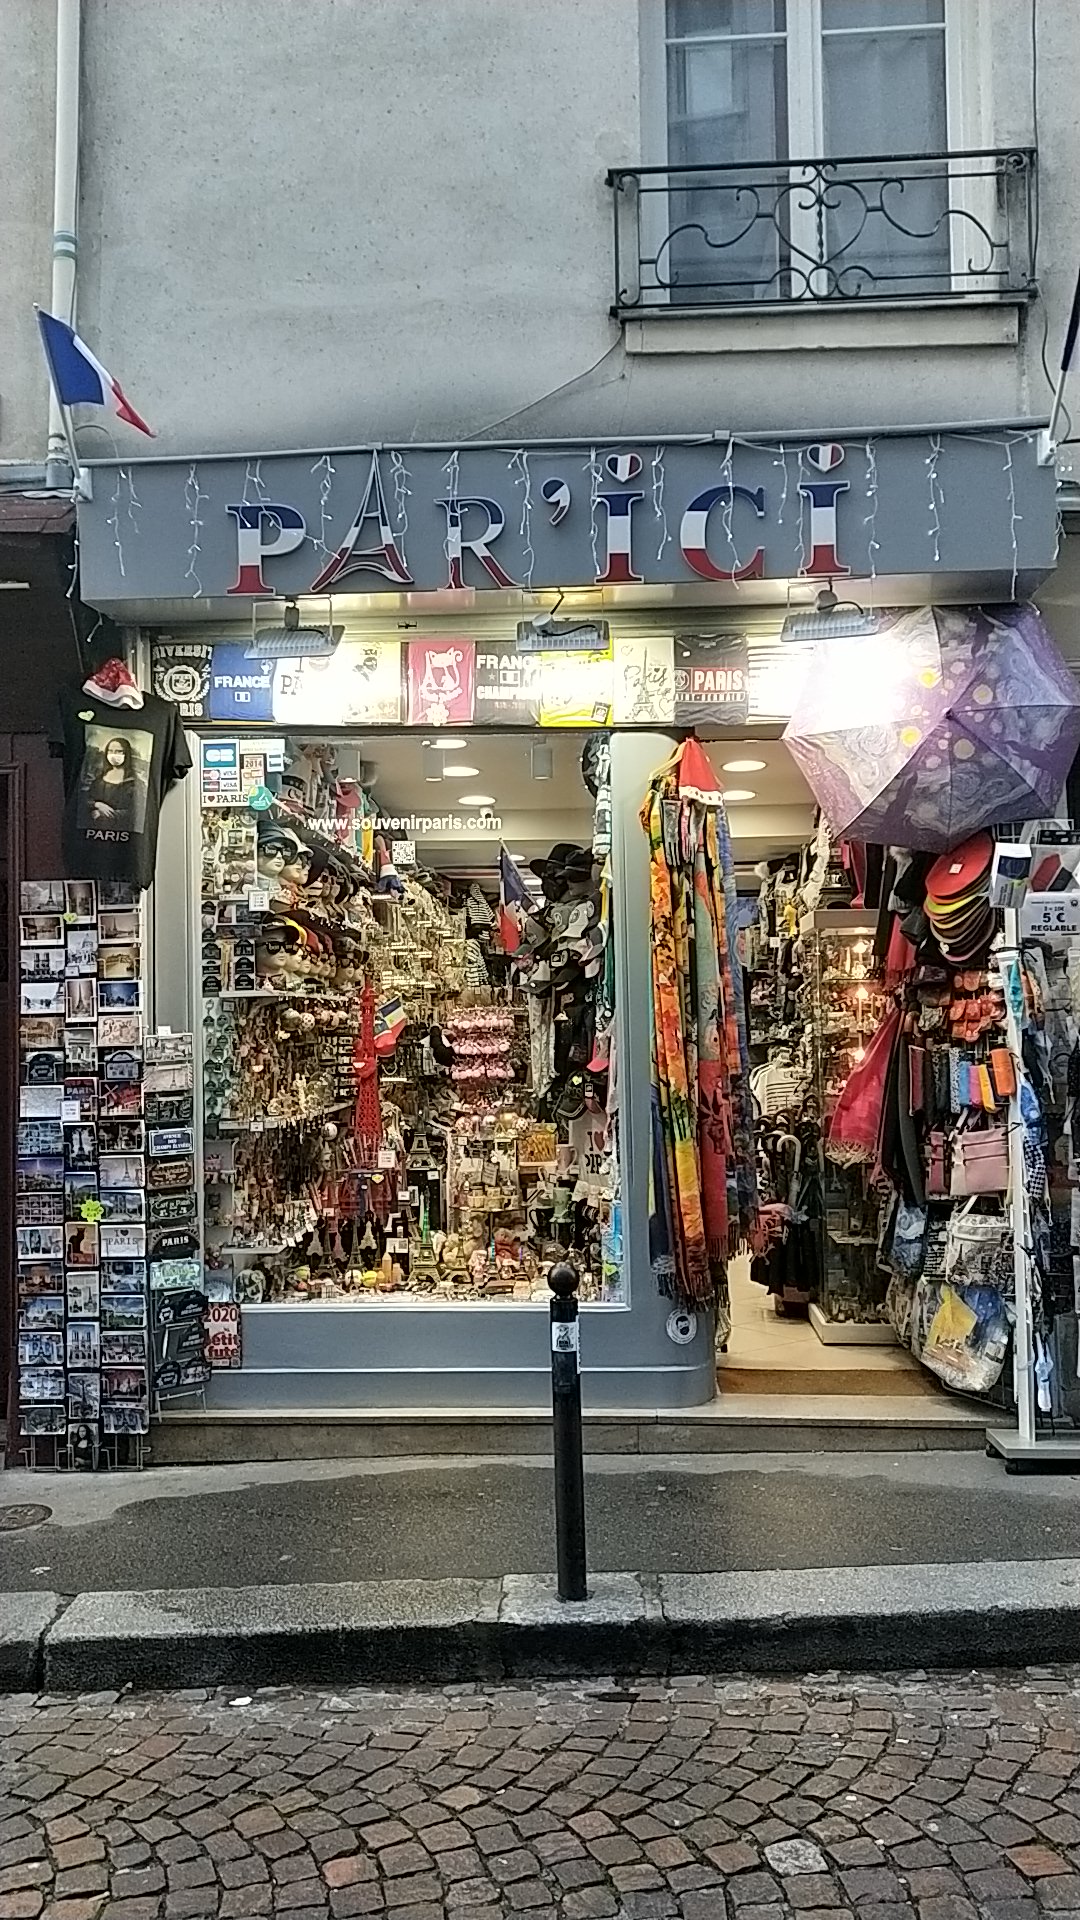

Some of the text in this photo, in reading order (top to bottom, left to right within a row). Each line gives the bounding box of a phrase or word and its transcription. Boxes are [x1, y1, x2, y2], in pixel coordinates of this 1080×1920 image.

[215, 676, 270, 688] FRANCE
[694, 670, 743, 691] PARIS
[176, 703, 203, 717] RIS
[245, 760, 262, 768] 2014
[216, 794, 248, 803] PARIS
[307, 814, 502, 833] www.souvenirparis.com
[86, 829, 130, 842] PARIS
[108, 1238, 138, 1246] PARIS
[162, 1236, 189, 1247] PARIS
[204, 1307, 239, 1323] 2020
